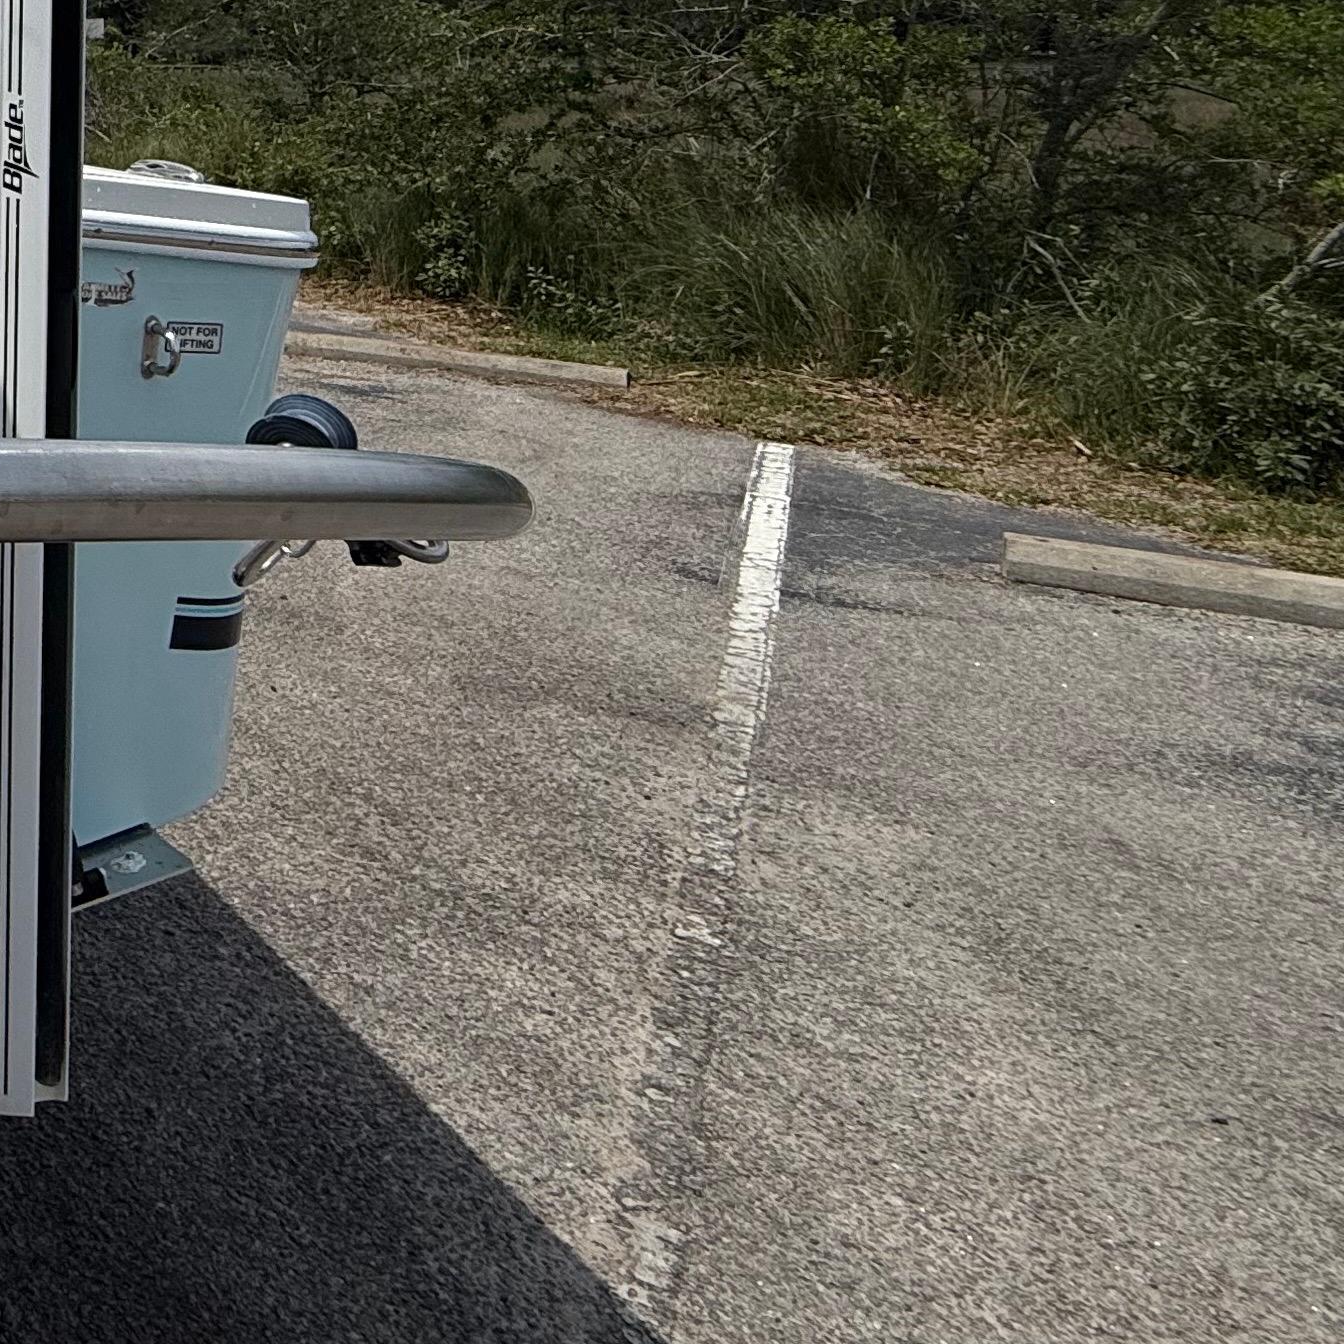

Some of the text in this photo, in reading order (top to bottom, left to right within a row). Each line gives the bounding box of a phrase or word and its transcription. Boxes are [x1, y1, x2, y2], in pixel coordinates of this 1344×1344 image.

[3, 102, 40, 195] Blade
[172, 326, 219, 337] NOT FOR
[179, 338, 214, 350] IFTING
